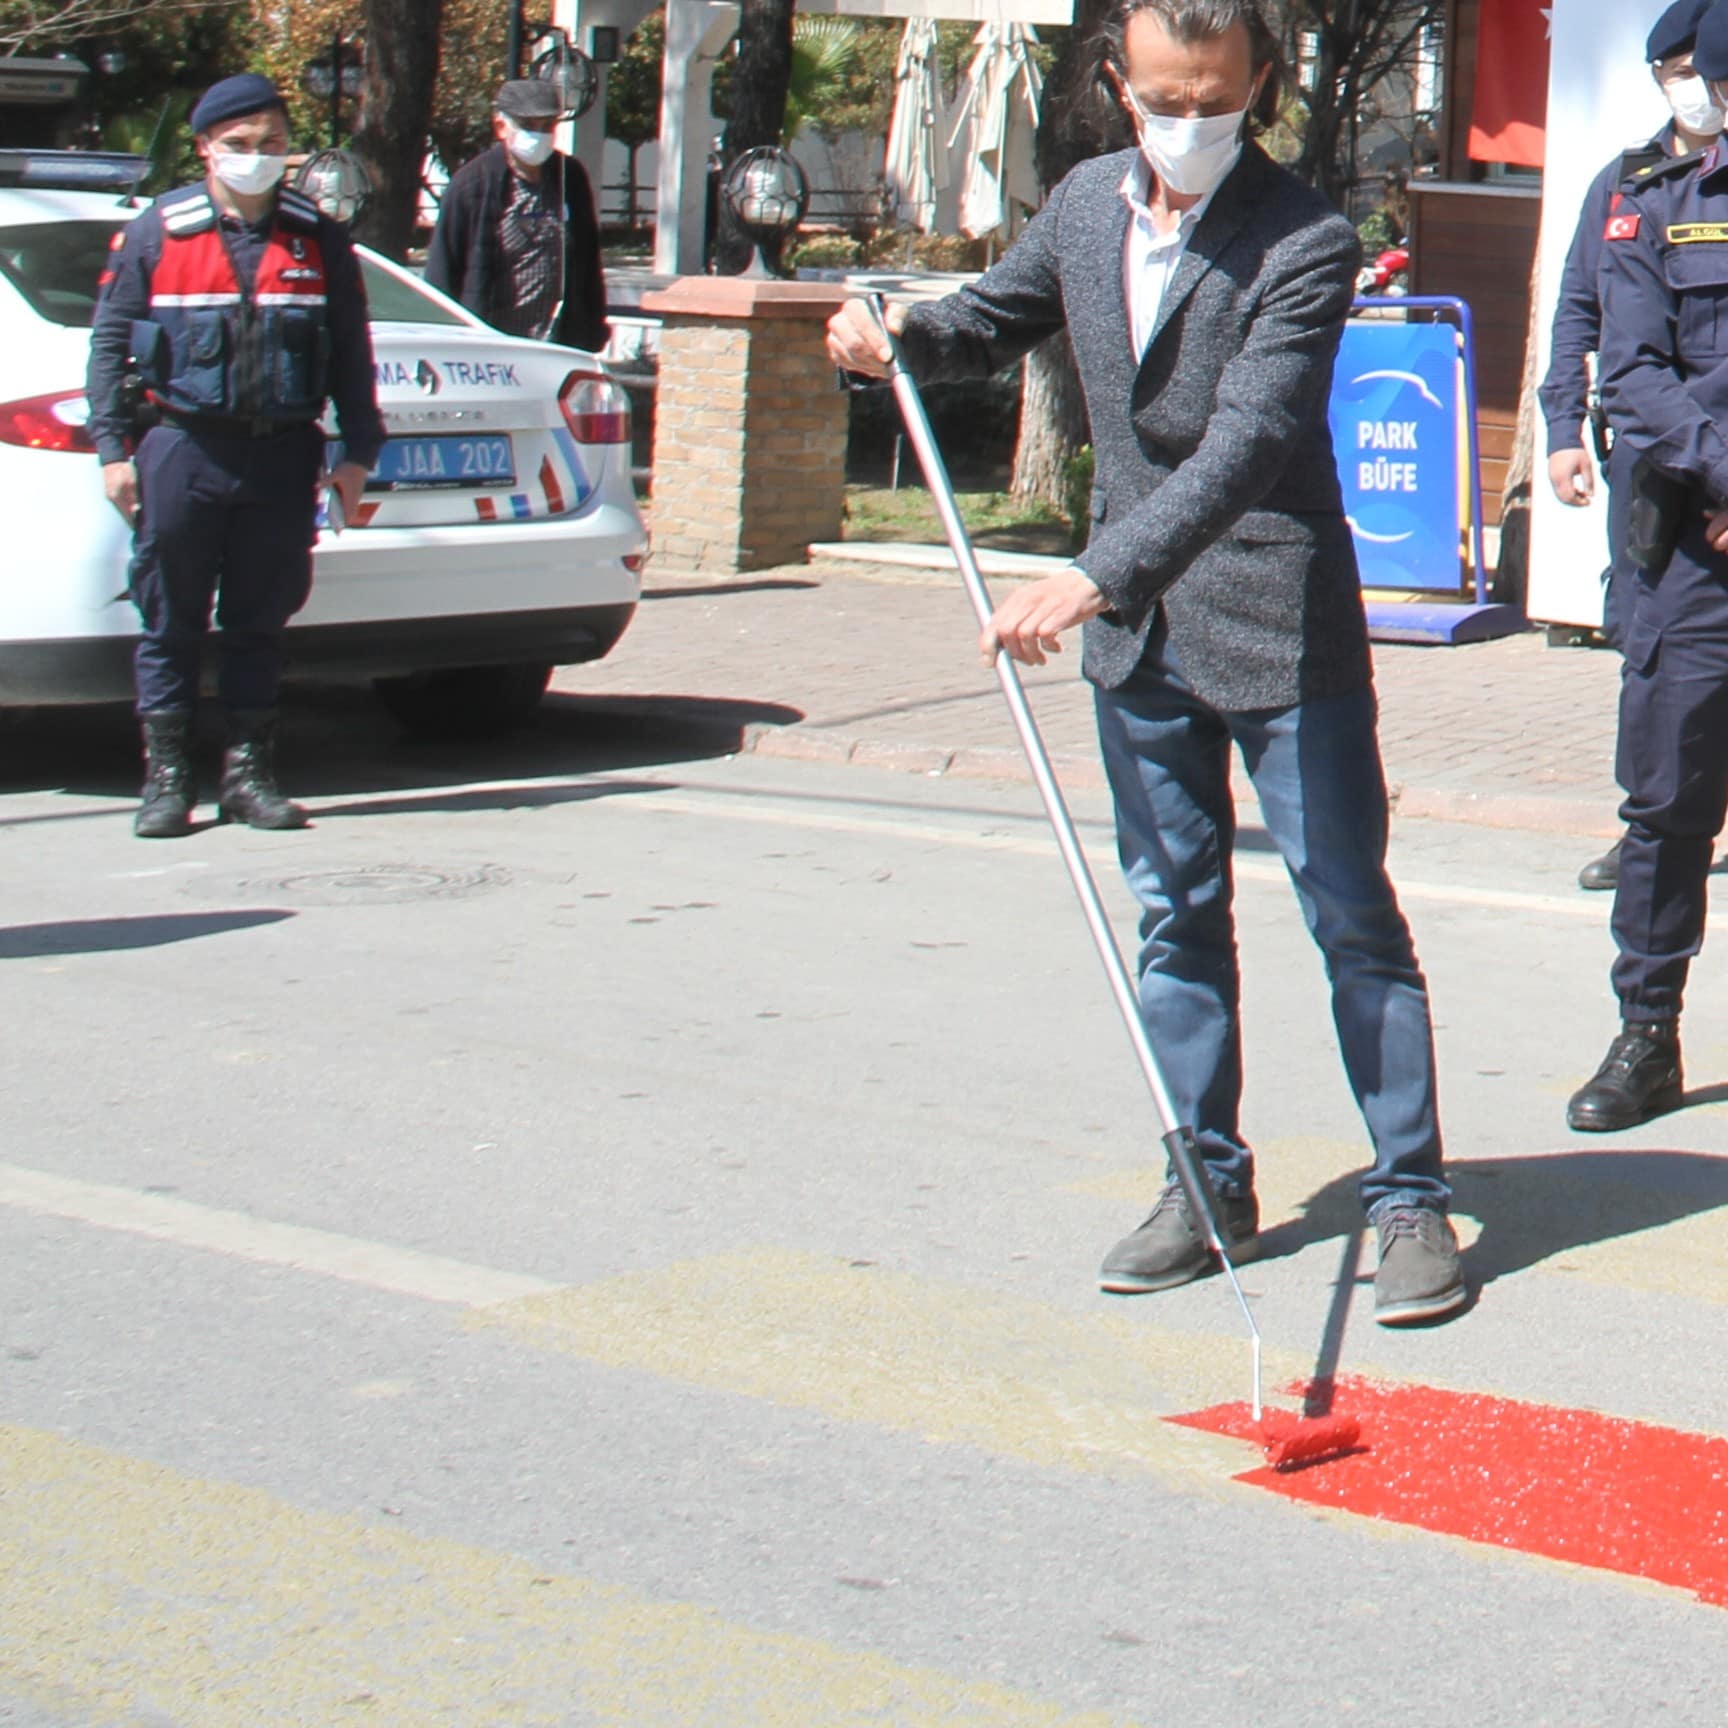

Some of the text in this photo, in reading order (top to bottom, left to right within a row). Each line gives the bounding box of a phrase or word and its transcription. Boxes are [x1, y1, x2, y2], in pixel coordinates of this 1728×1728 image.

[1357, 420, 1418, 450] PARK
[397, 440, 510, 476] JAA 202
[1357, 455, 1418, 492] BÜFE
